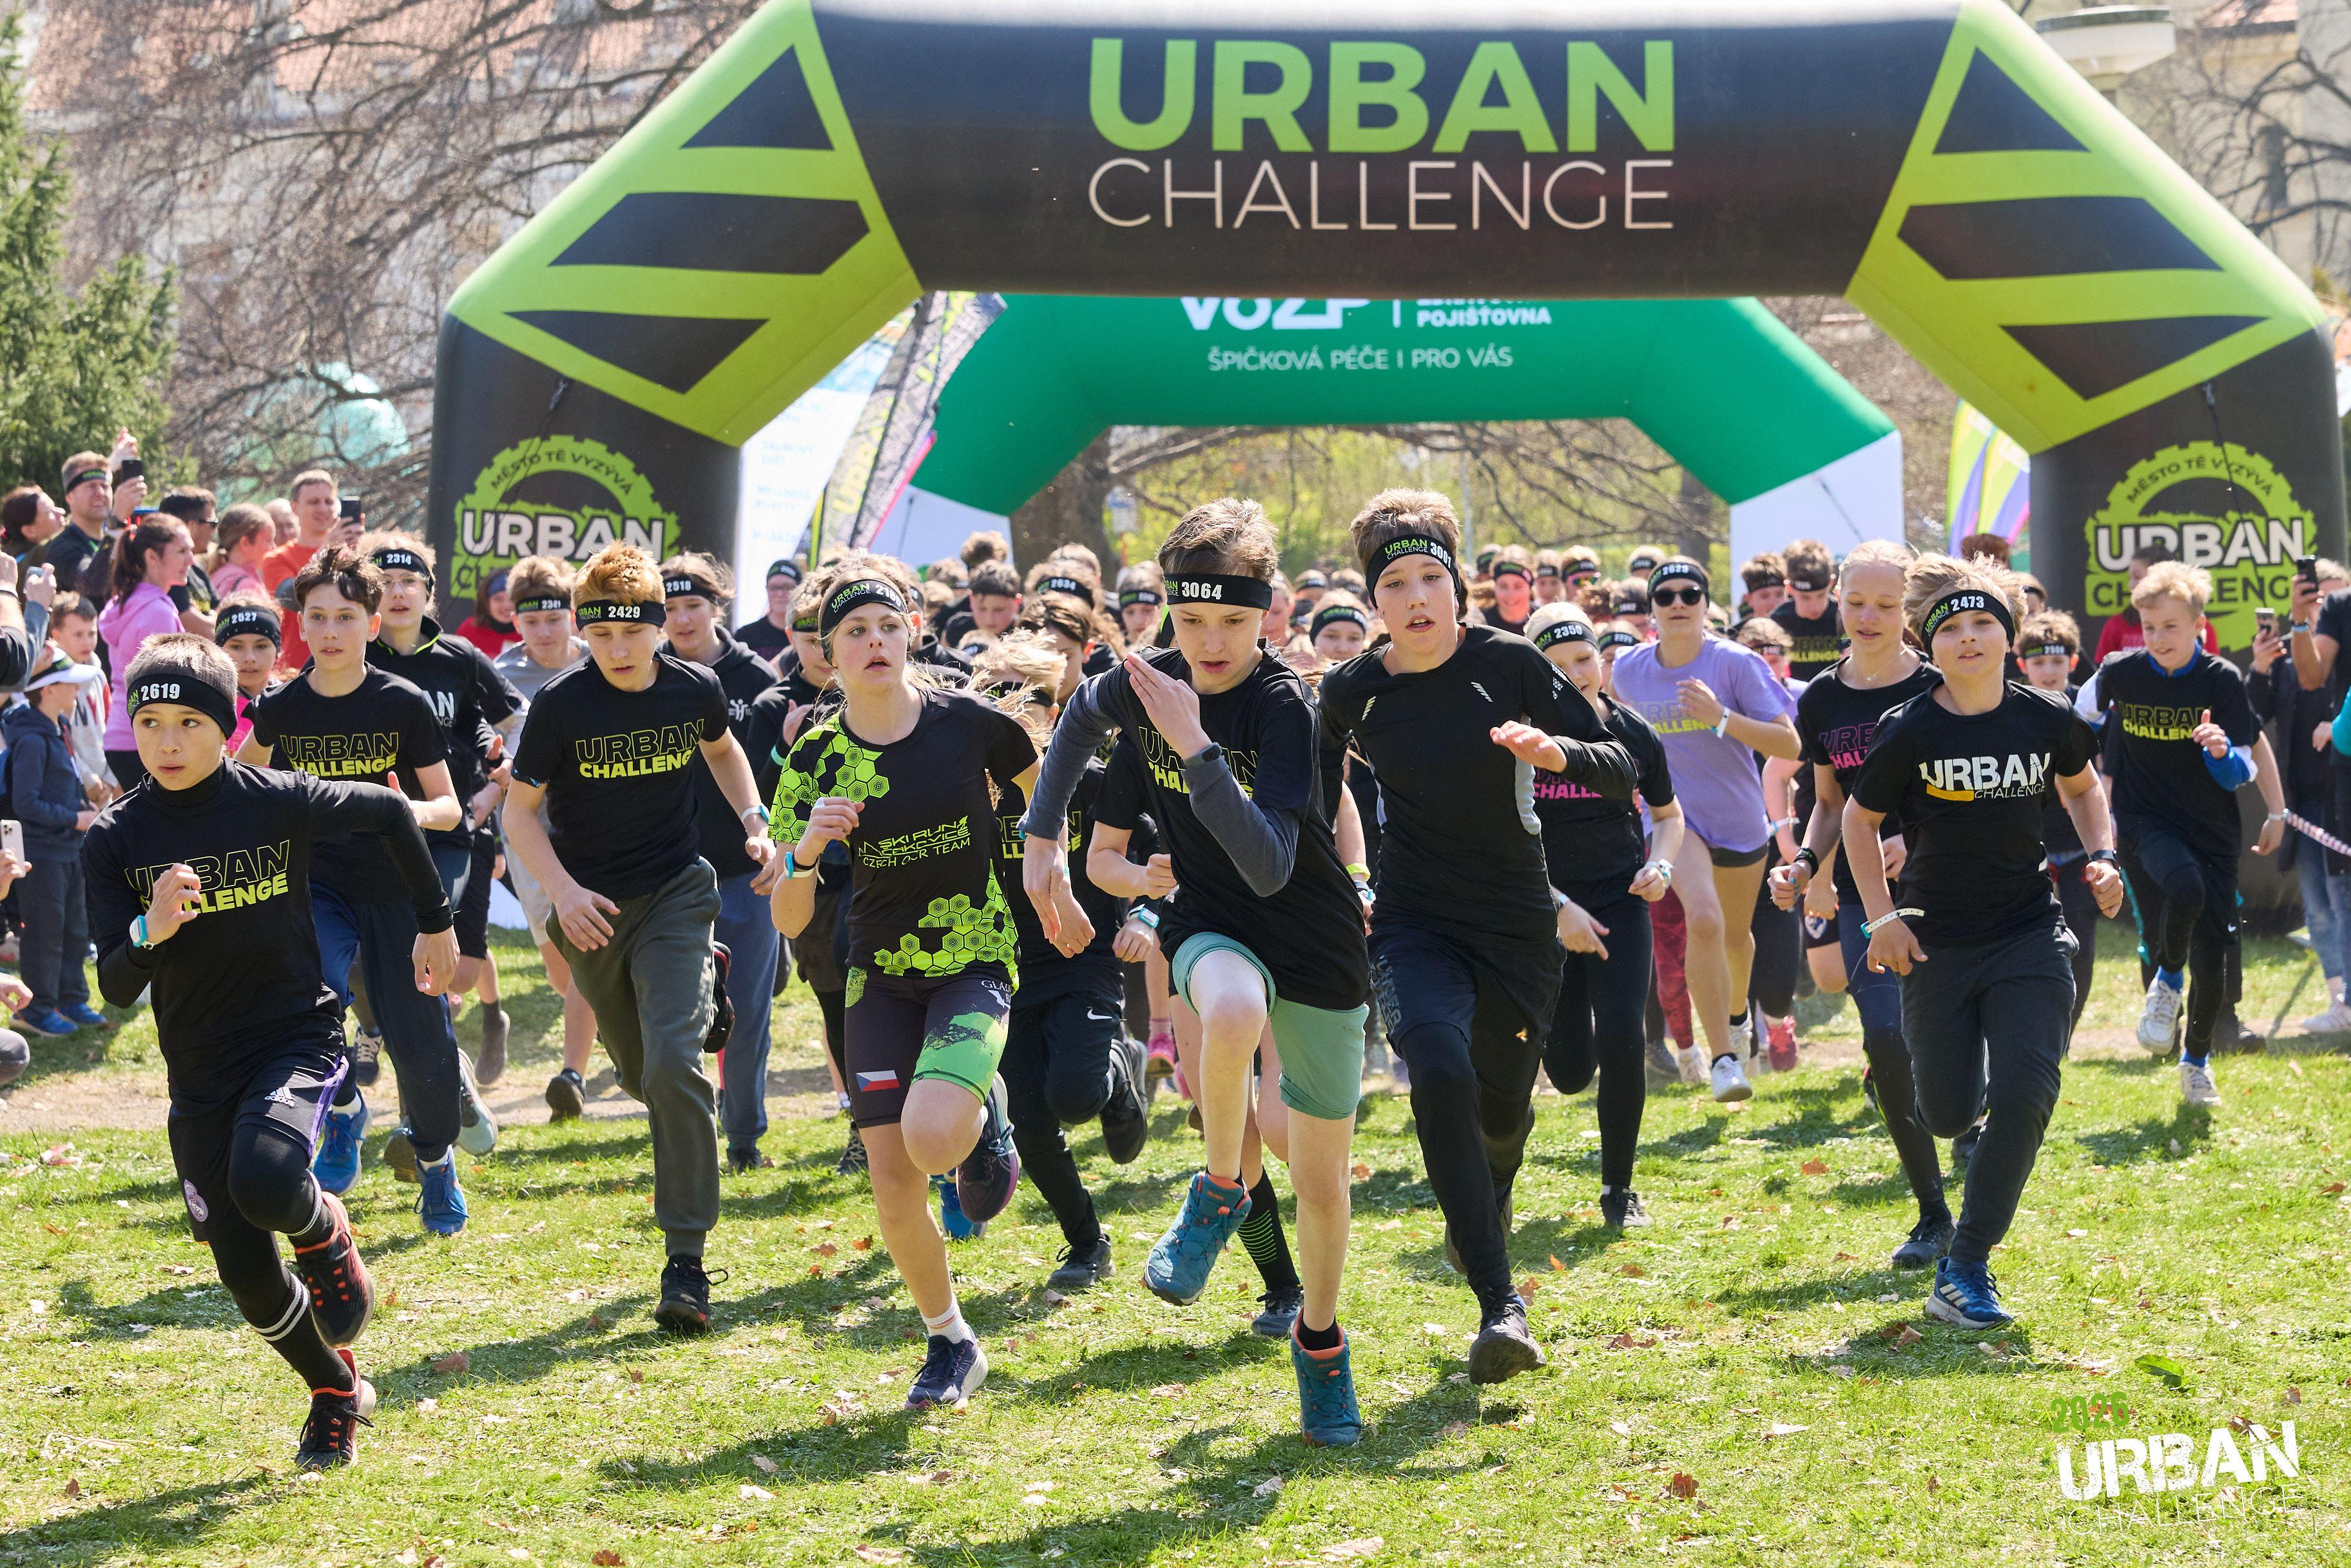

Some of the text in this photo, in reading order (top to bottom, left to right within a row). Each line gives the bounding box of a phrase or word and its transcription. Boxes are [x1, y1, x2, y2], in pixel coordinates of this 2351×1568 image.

[1089, 39, 1674, 152] URBAN
[1088, 157, 1674, 231] CHALLENGE
[1207, 345, 1324, 372] ŠPIČKOVÁ
[1331, 344, 1389, 371] PÉČE
[1412, 348, 1461, 369] PRO
[1467, 342, 1514, 368] VÁS
[571, 453, 633, 496] VYZÝVÁ
[2127, 463, 2180, 503] MĚSTO
[461, 511, 664, 561] URBAN
[1384, 539, 1427, 554] URBAN
[387, 553, 411, 565] 2314
[1387, 546, 1428, 559] CHALLENGE
[1430, 542, 1451, 568] 3001
[831, 583, 871, 608] URBAN
[833, 589, 871, 613] CHALLENGE
[1182, 581, 1222, 600] 3064
[608, 605, 641, 619] 2429
[1924, 595, 1984, 633] URBAN 2473
[1554, 625, 1583, 639] 2350
[140, 683, 181, 702] 2619
[280, 732, 399, 762] URBAN
[576, 718, 704, 764] URBAN
[1919, 752, 2051, 791] URBAN
[1974, 782, 2046, 799] CHALLENGE
[878, 821, 956, 848] SKI RUN
[933, 837, 971, 855] TEAM
[264, 1096, 295, 1107] adidas
